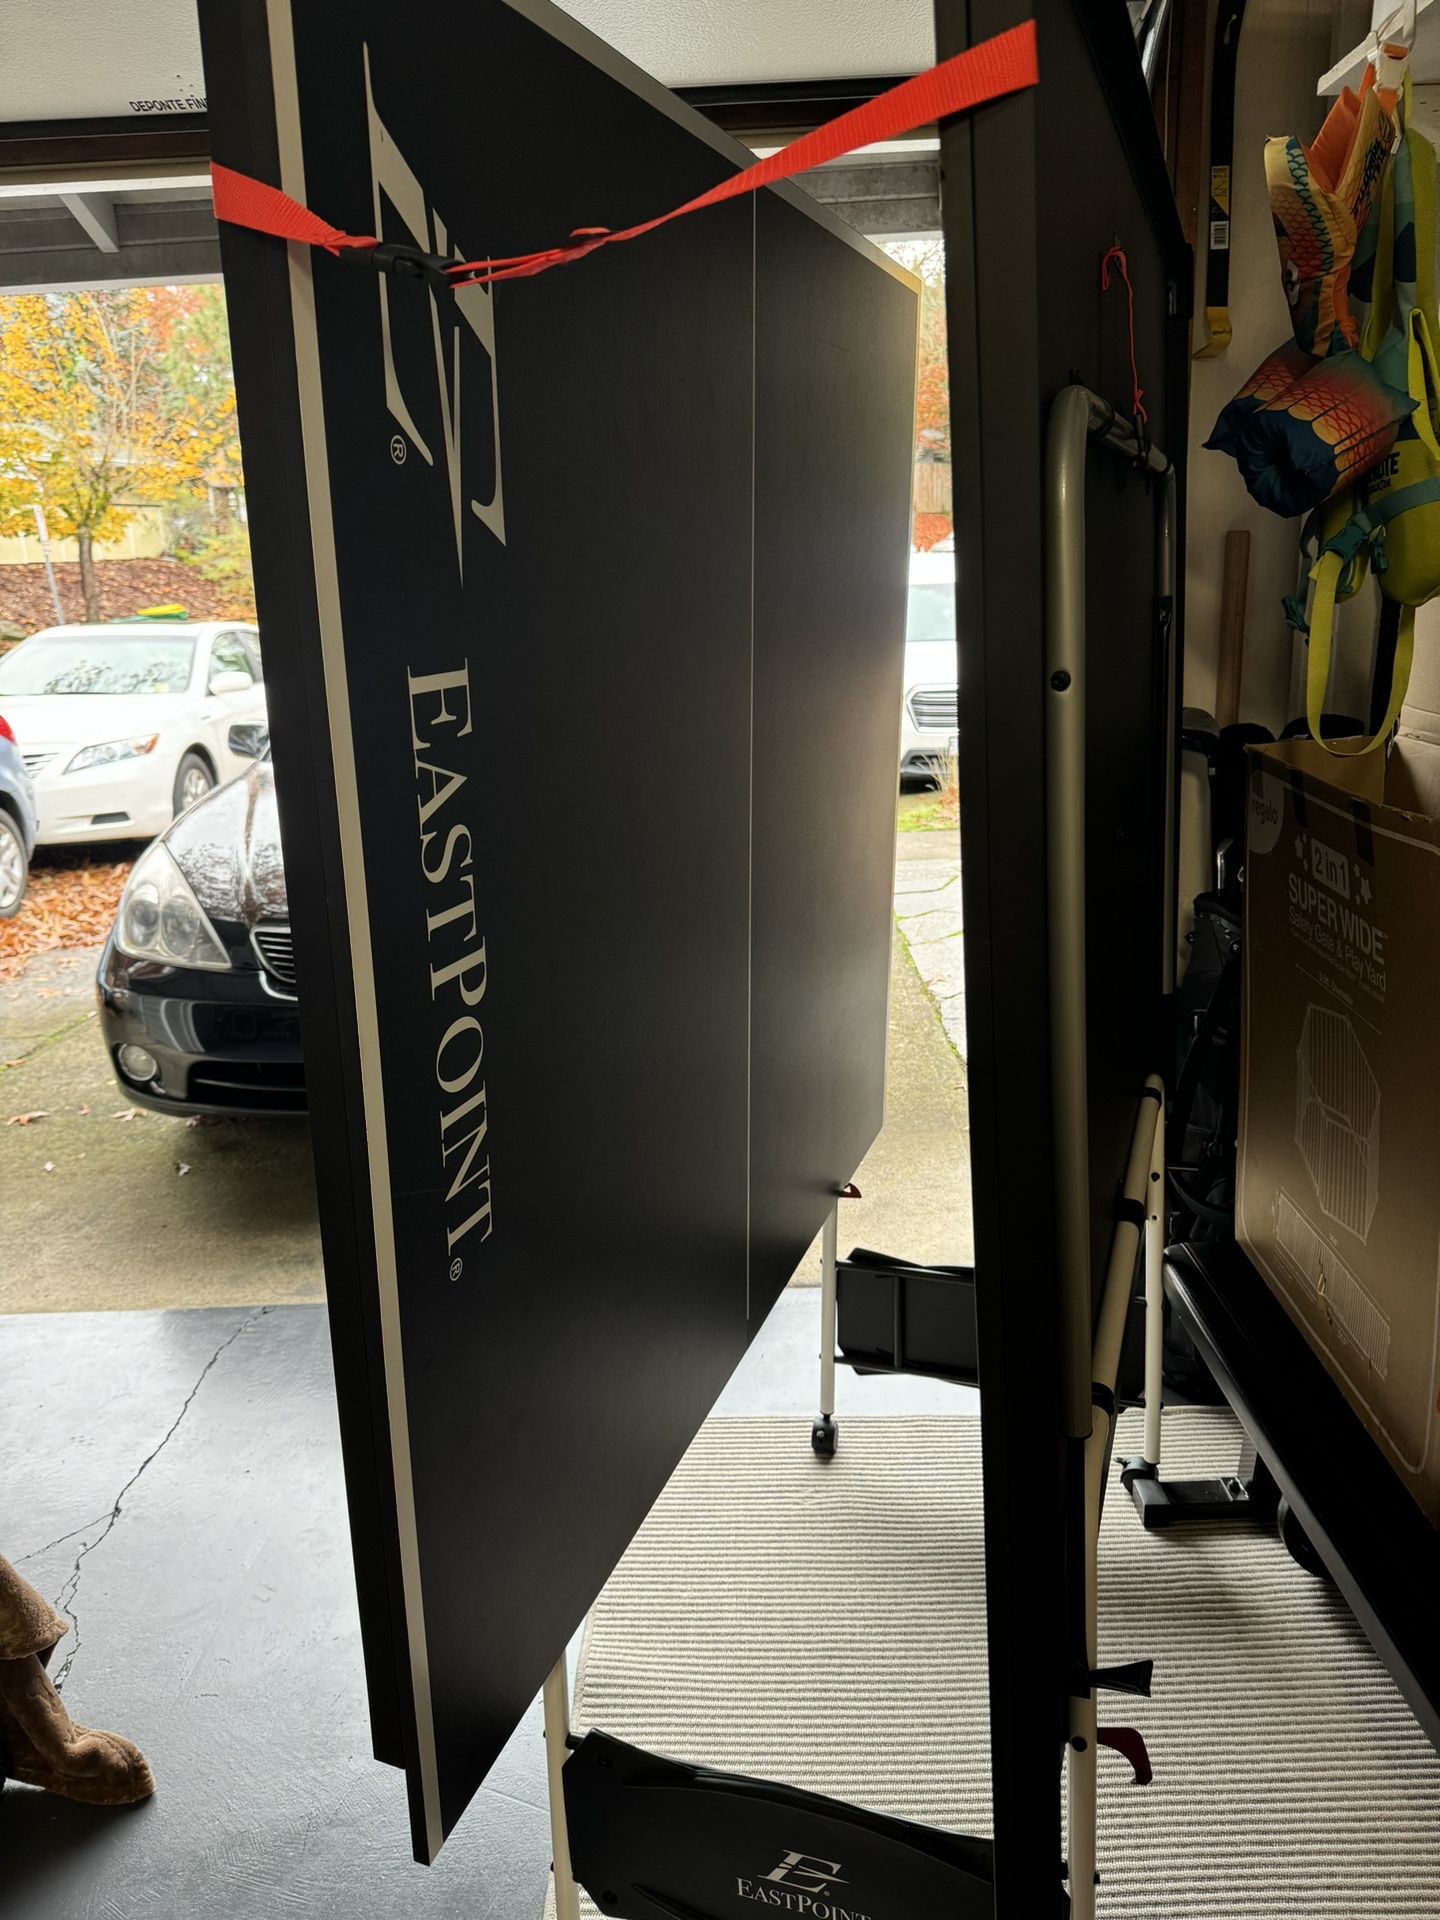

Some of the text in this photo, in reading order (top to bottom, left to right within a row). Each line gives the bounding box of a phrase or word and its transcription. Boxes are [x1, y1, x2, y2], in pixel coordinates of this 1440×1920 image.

[128, 100, 186, 112] DEPONTE
[1250, 799, 1279, 827] regalo
[1314, 847, 1349, 893] 2 in 1
[1288, 871, 1339, 927] SUPER
[1288, 905, 1314, 941] Safety
[1315, 923, 1335, 953] Gate
[1336, 941, 1344, 958] &
[1345, 945, 1365, 979] Play
[1364, 961, 1387, 991] Yard
